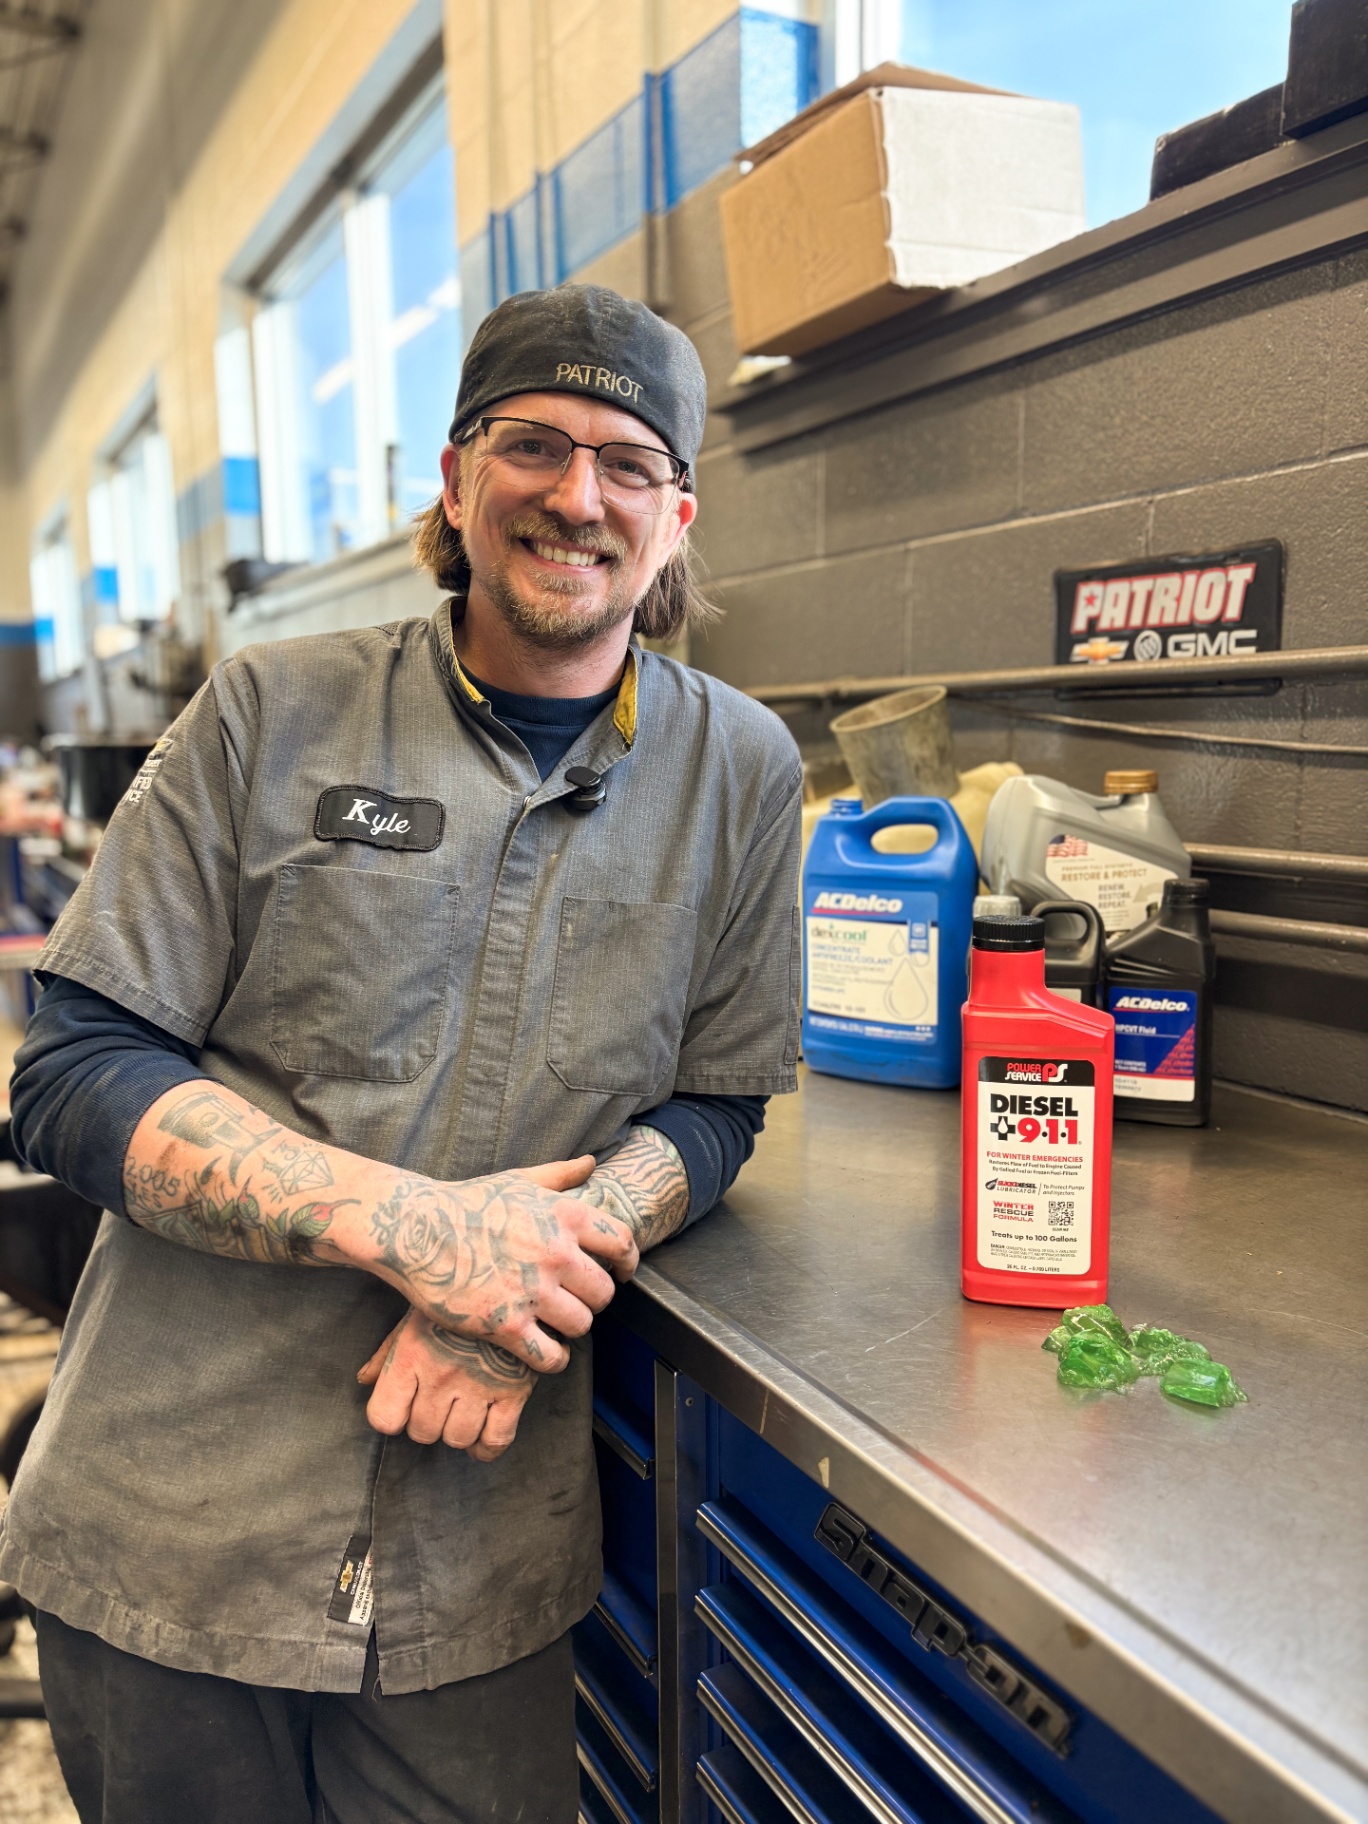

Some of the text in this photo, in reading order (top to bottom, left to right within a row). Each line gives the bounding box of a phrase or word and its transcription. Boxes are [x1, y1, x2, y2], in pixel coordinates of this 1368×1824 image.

[555, 363, 644, 404] PATRIOT
[1070, 562, 1257, 634] PATRIOT
[1167, 629, 1257, 658] GMC
[341, 798, 412, 836] Kyle
[1061, 868, 1148, 882] RESTORE & PROTECT
[813, 892, 904, 914] ACDelco
[1115, 995, 1189, 1013] ACDelco
[1006, 1062, 1041, 1072] POWER
[1004, 1071, 1041, 1082] SERVICE
[990, 1093, 1079, 1117] DIESEL
[986, 1150, 1084, 1163] FOR WINTER EMERGENCIES
[996, 1186, 1036, 1195] LUBRICATOR
[993, 1200, 1034, 1210] WINTER
[993, 1207, 1035, 1217] RESCUE
[993, 1213, 1034, 1223] FORMULA
[991, 1230, 1013, 1239] Treats
[1014, 1233, 1024, 1242] up
[1034, 1234, 1048, 1242] 100
[1049, 1235, 1078, 1243] Gallons
